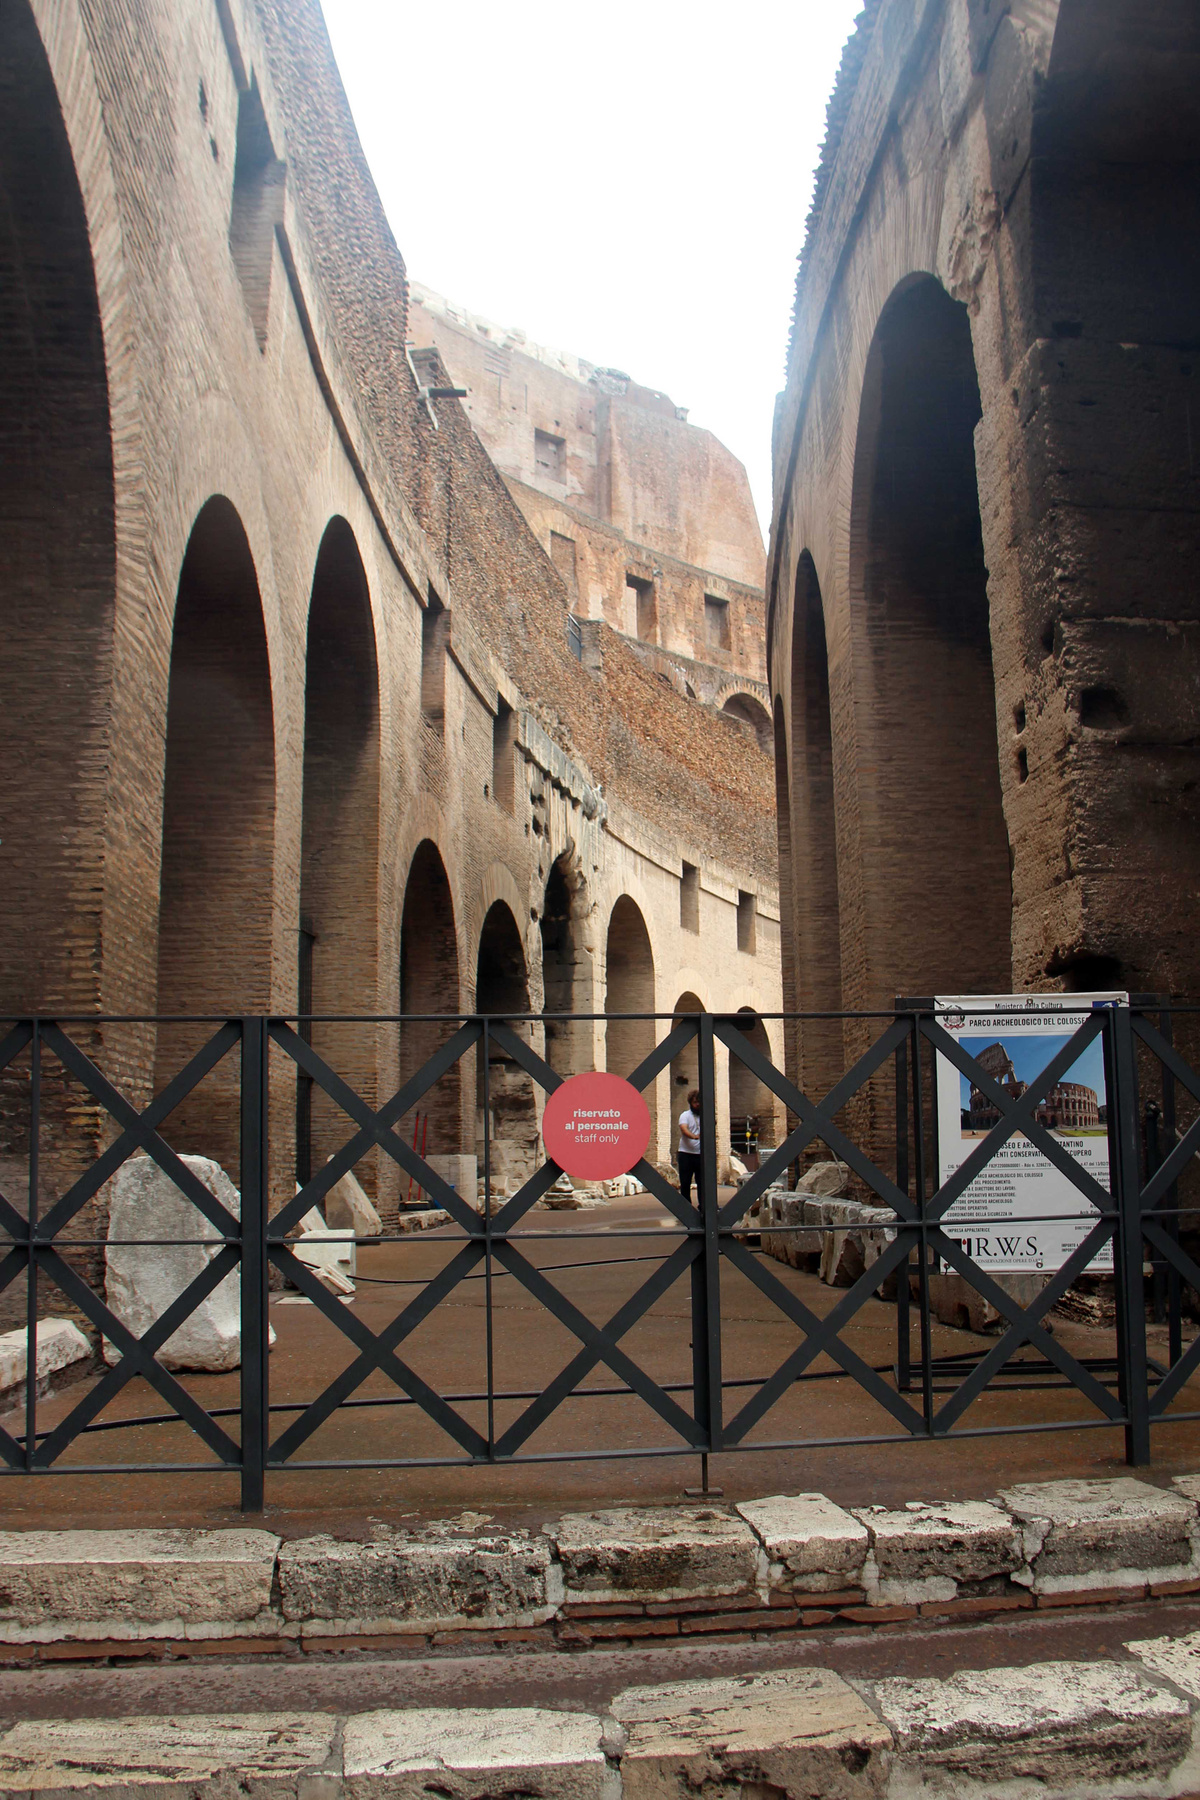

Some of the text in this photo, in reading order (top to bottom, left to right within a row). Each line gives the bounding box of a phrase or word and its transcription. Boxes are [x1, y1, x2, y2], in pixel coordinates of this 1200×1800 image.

[969, 1019, 991, 1027] PARCO
[992, 1018, 1042, 1026] ARCHEOLOGICO
[1057, 1017, 1086, 1025] COLOSSE
[573, 1108, 621, 1118] riservato
[565, 1120, 629, 1132] al personale
[574, 1133, 620, 1145] staff only
[1022, 1141, 1035, 1149] ARC
[975, 1236, 1043, 1256] R.W.S.
